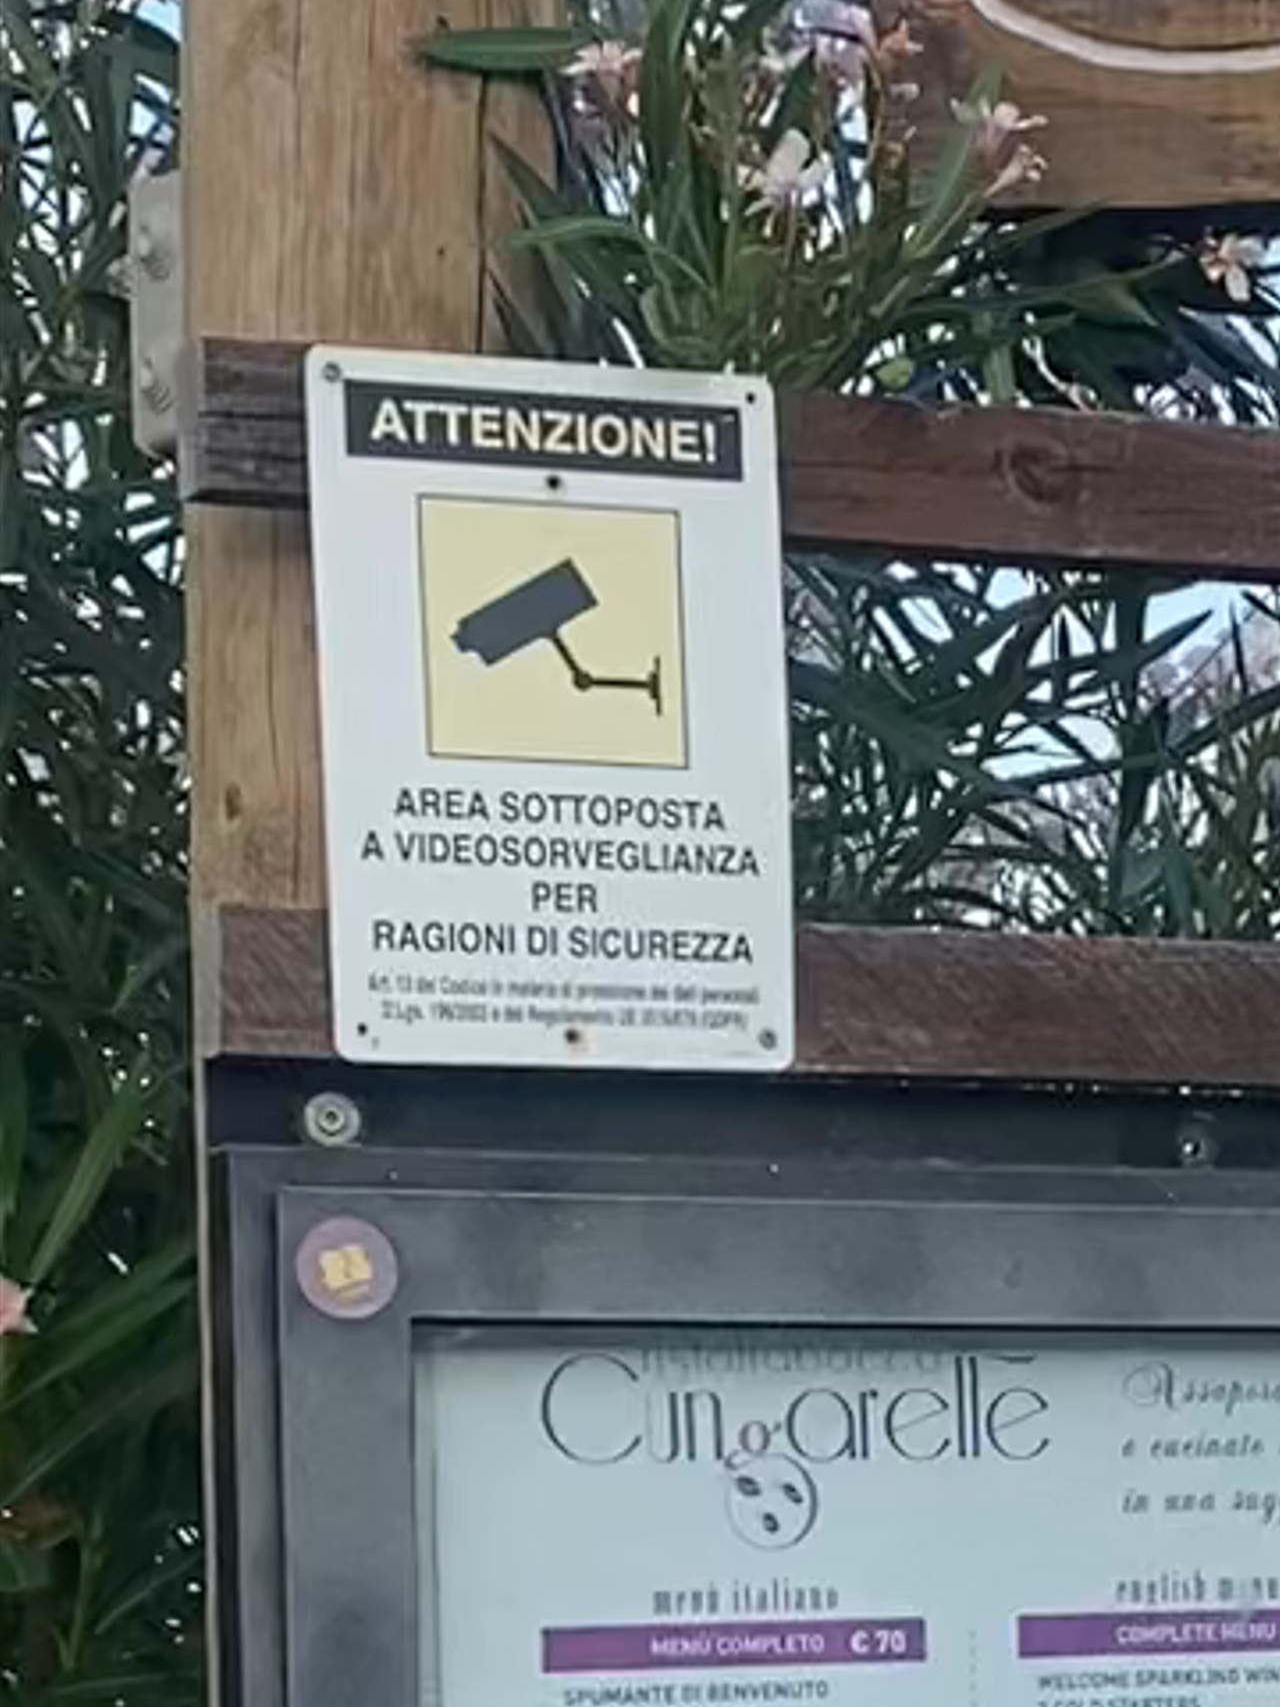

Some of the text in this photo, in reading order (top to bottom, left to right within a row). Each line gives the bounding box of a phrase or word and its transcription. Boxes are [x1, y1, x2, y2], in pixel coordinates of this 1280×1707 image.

[370, 398, 717, 463] ATTENZIONE!
[394, 788, 725, 830] AREA SOTTOPOSTA
[361, 832, 760, 877] A VIDEOSORVEGLIANZA
[531, 883, 598, 914] PER
[372, 920, 754, 963] RAGIONI DI SICUREZZA
[716, 1633, 825, 1656] COMPLETO
[876, 1630, 906, 1652] 70
